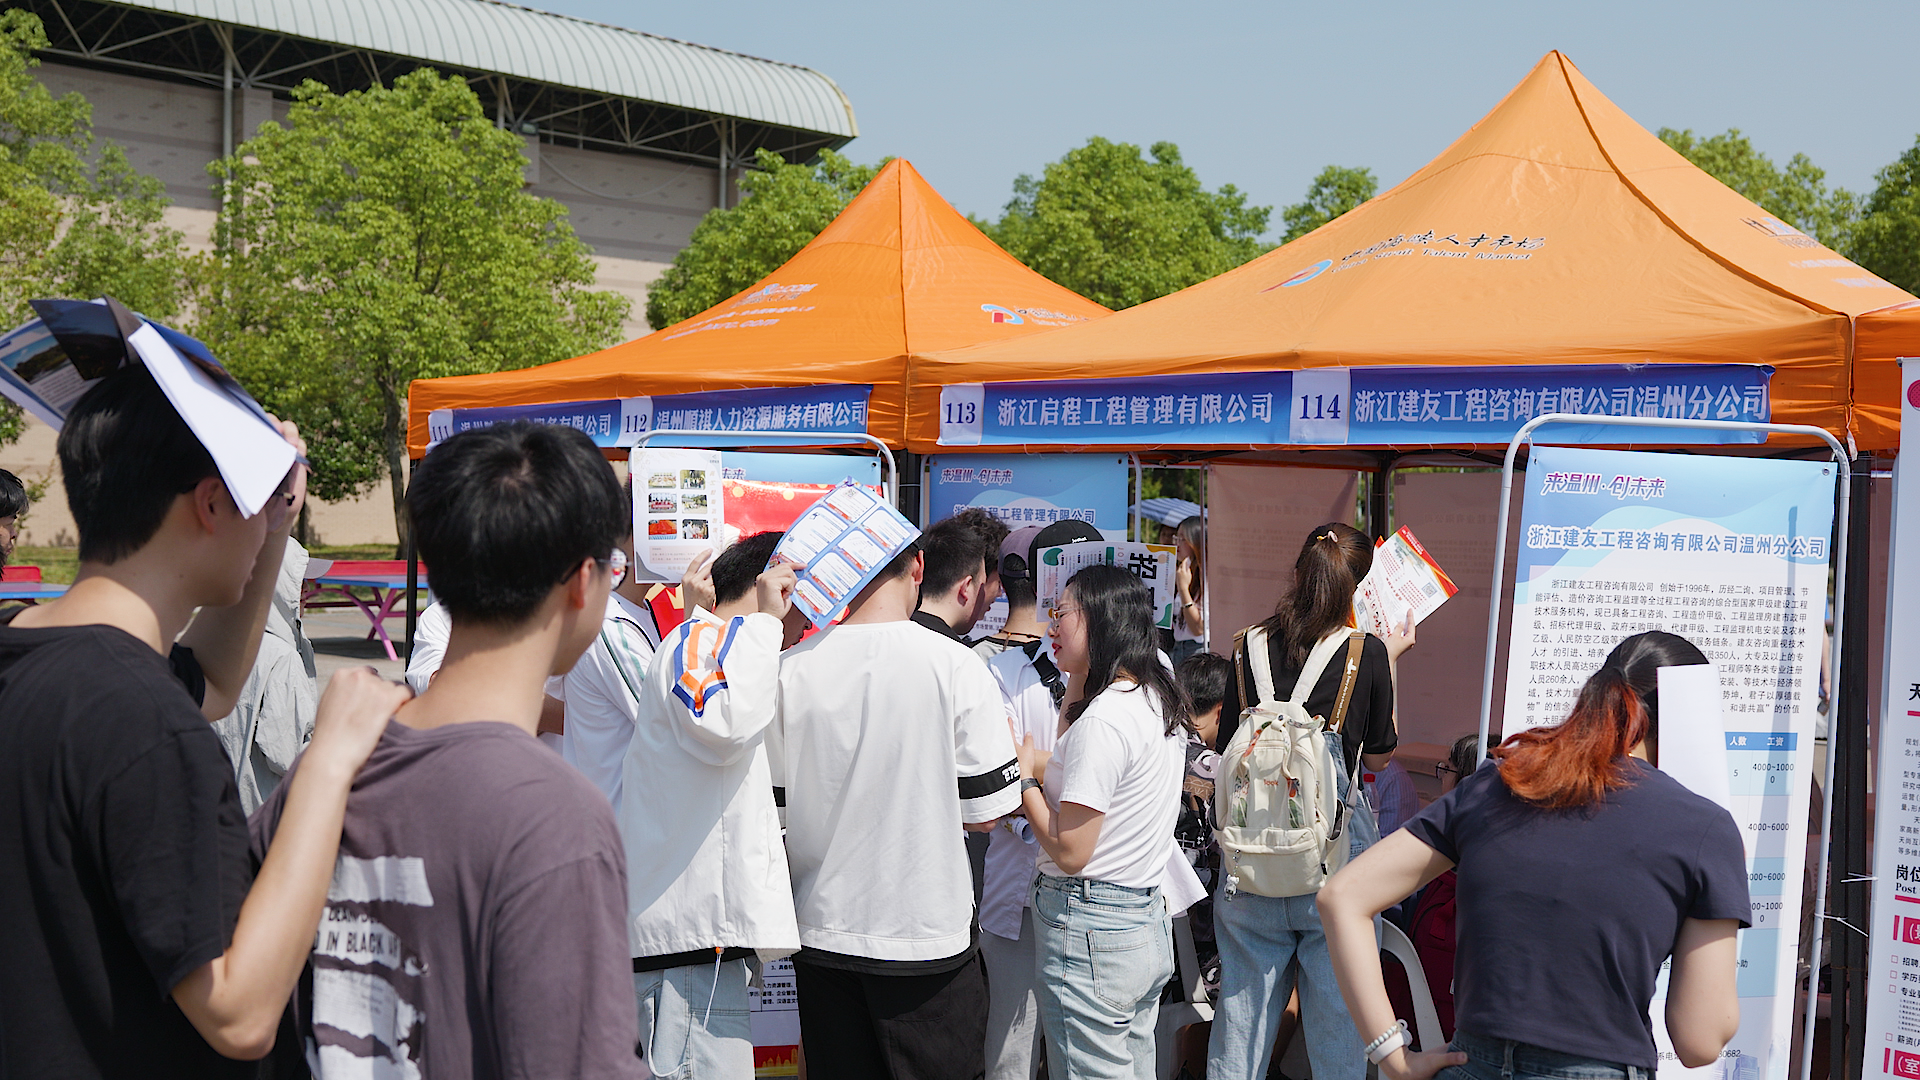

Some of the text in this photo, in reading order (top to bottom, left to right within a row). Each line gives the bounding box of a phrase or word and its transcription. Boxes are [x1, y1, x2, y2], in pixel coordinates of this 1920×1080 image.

[1421, 248, 1469, 258] Talent
[1474, 252, 1532, 260] Market
[997, 392, 1273, 427] 浙江启程工程管理有限公司
[1299, 394, 1341, 420] 114
[1354, 384, 1768, 423] 浙江建友工程咨询有限公司温州分公司
[944, 402, 976, 424] 113
[625, 414, 647, 432] 112
[432, 424, 449, 442] 111
[1543, 472, 1666, 499] 来温州·创未来
[1528, 527, 1825, 557] 浙江建友工程咨询有限公司温州分公司
[1551, 579, 1654, 592] 浙江建友工程咨询有限公司
[1730, 736, 1747, 746] 人数
[1767, 737, 1784, 746] 工资
[1734, 769, 1738, 777] 5
[1753, 763, 1794, 771] 4000~1000
[1748, 823, 1789, 831] 4000~6000
[1896, 883, 1917, 894] Post
[327, 931, 340, 952] IN
[347, 932, 384, 955] BLACK
